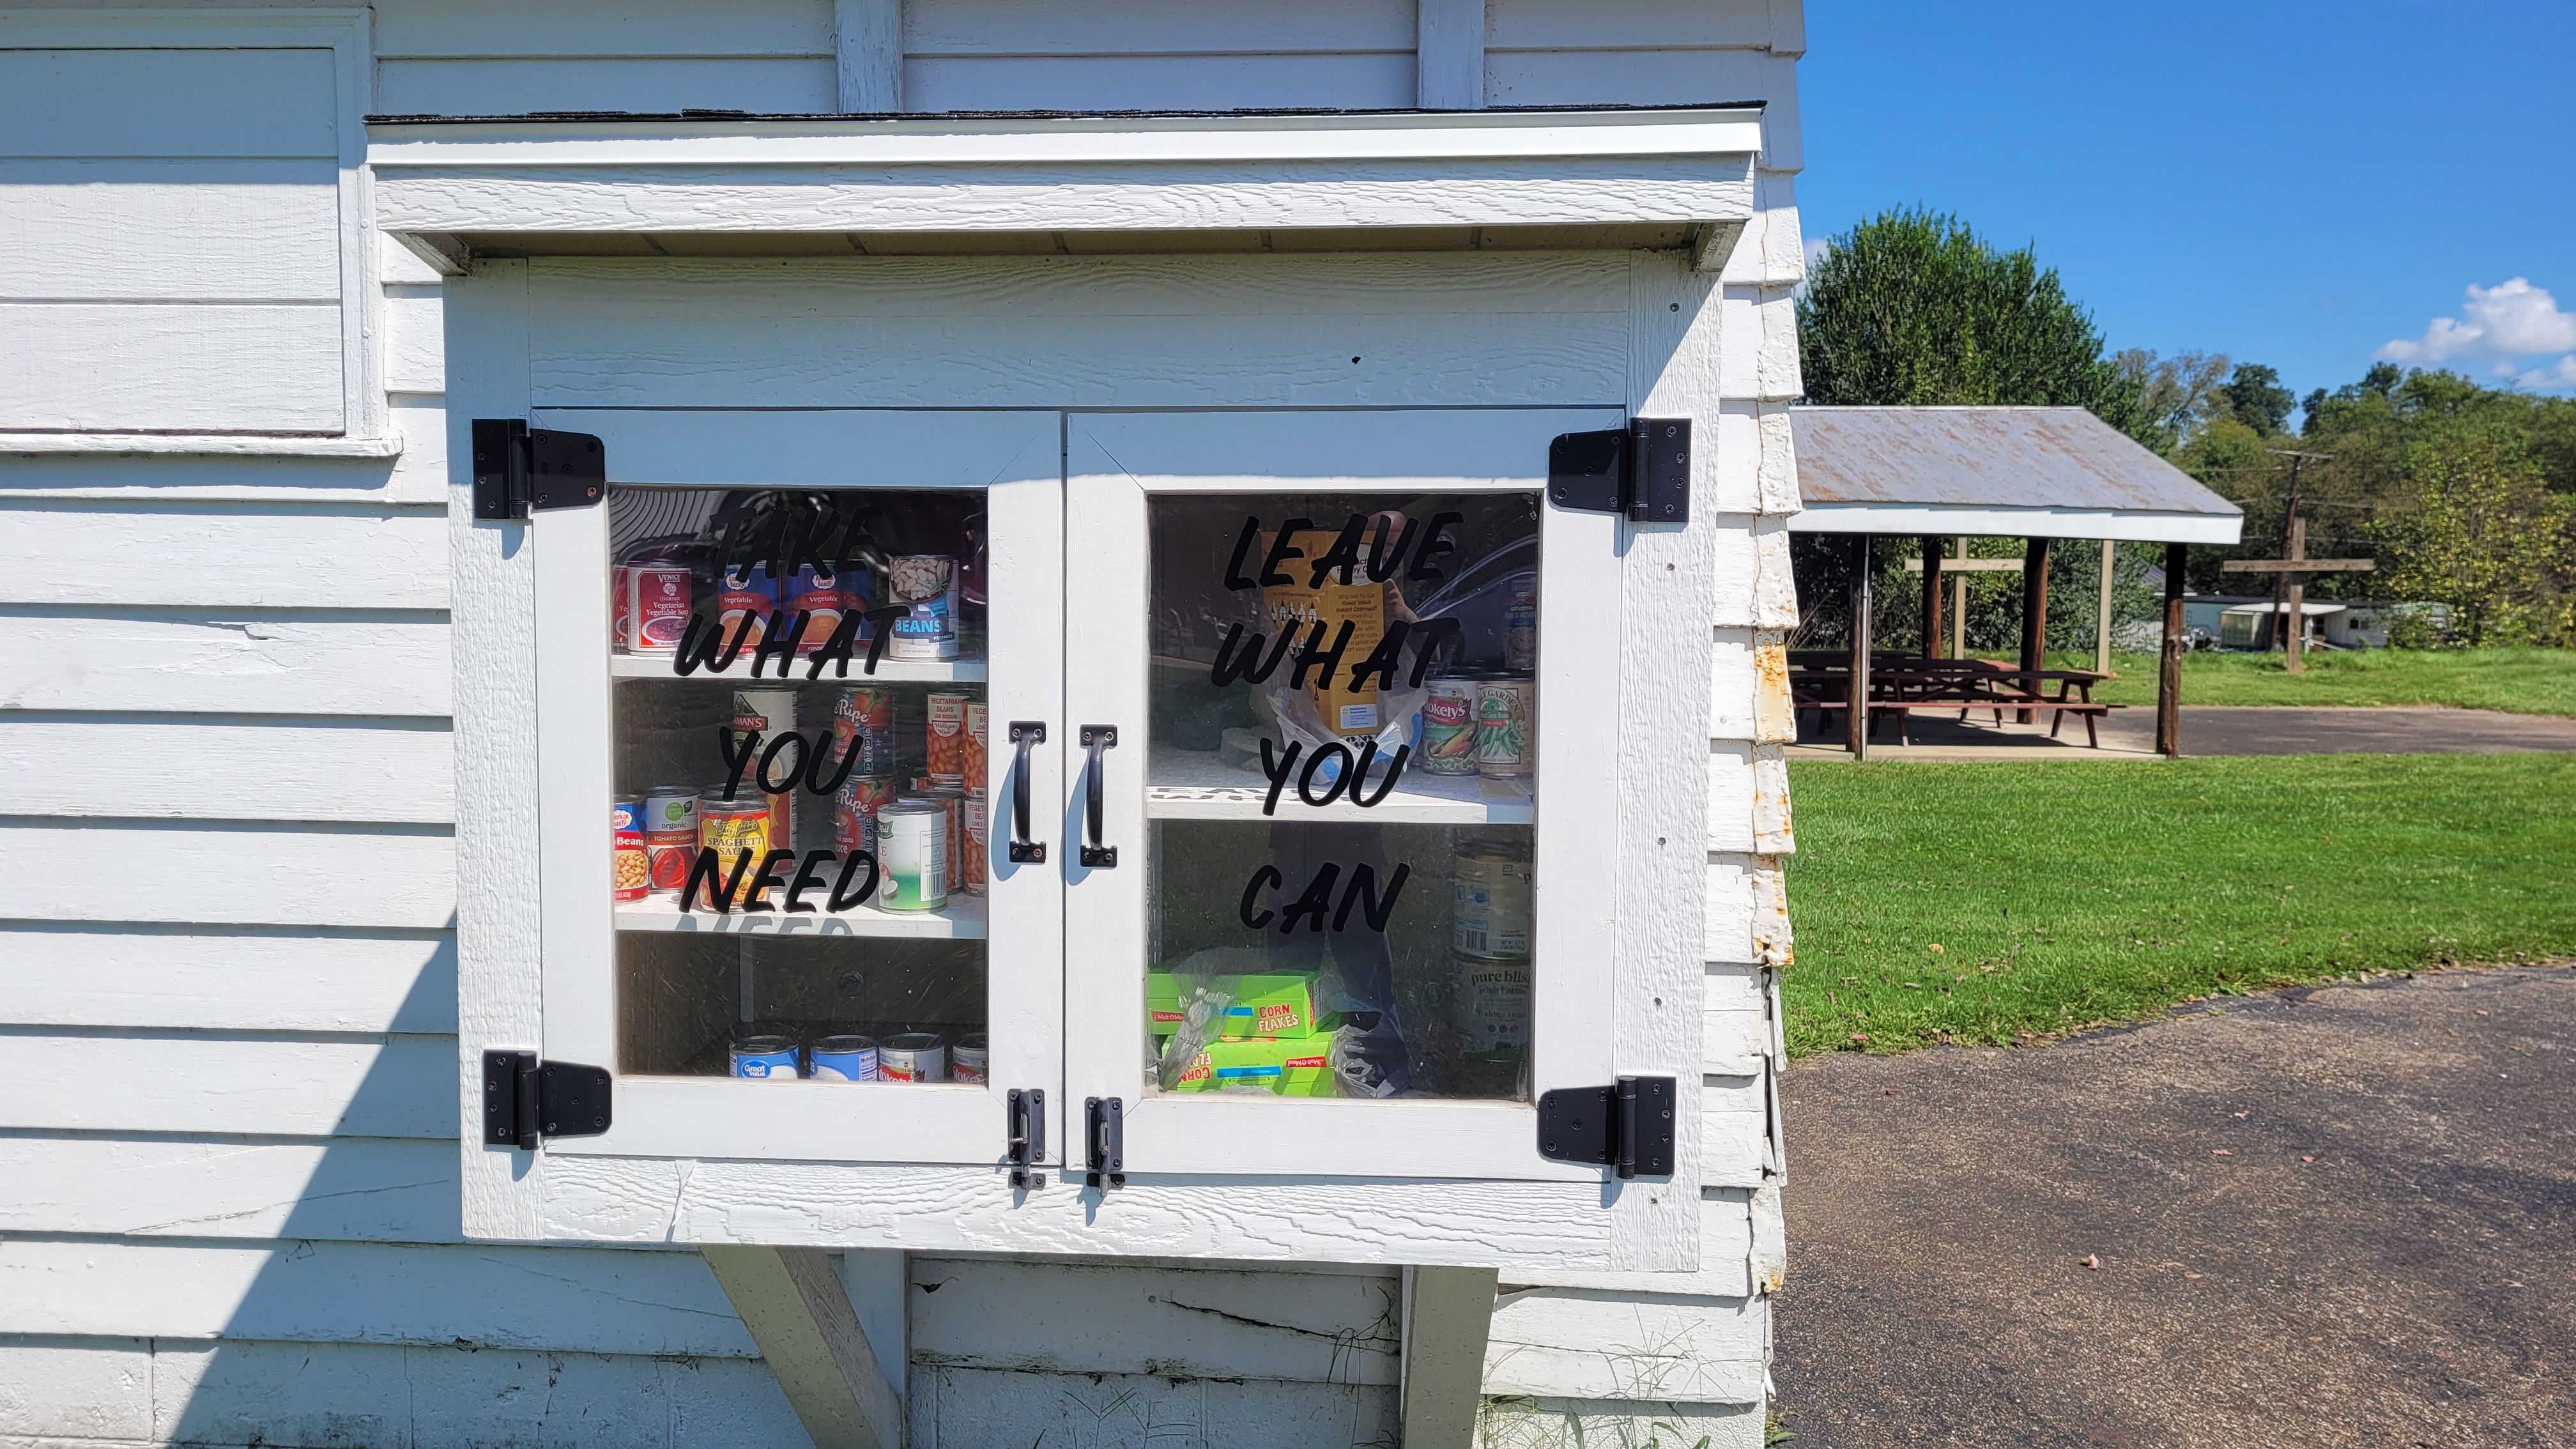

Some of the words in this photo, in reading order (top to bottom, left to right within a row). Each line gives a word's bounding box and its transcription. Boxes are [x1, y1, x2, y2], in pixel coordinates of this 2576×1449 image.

[710, 506, 885, 582] TAKE
[1223, 512, 1464, 591] LEAVE
[657, 574, 681, 583] VENICE
[654, 601, 685, 610] Vegetarian
[809, 595, 838, 603] Vegetable
[647, 609, 677, 618] Vegetable
[894, 620, 942, 632] BEANS
[673, 606, 910, 681] WHAT
[1211, 617, 1460, 693] WHAT
[1487, 689, 1521, 712] GARDEN
[720, 726, 863, 802] YOU
[1260, 737, 1410, 816] YOU
[661, 821, 687, 830] organic
[716, 824, 735, 836] Chef
[736, 820, 758, 835] John's
[617, 836, 645, 846] Beans
[707, 836, 765, 847] SPAGHETTI
[678, 845, 879, 914] NEED
[1240, 862, 1411, 934] CAN
[1471, 972, 1501, 986] pure
[1259, 1004, 1291, 1018] CORN
[1257, 1014, 1300, 1032] FLAKES
